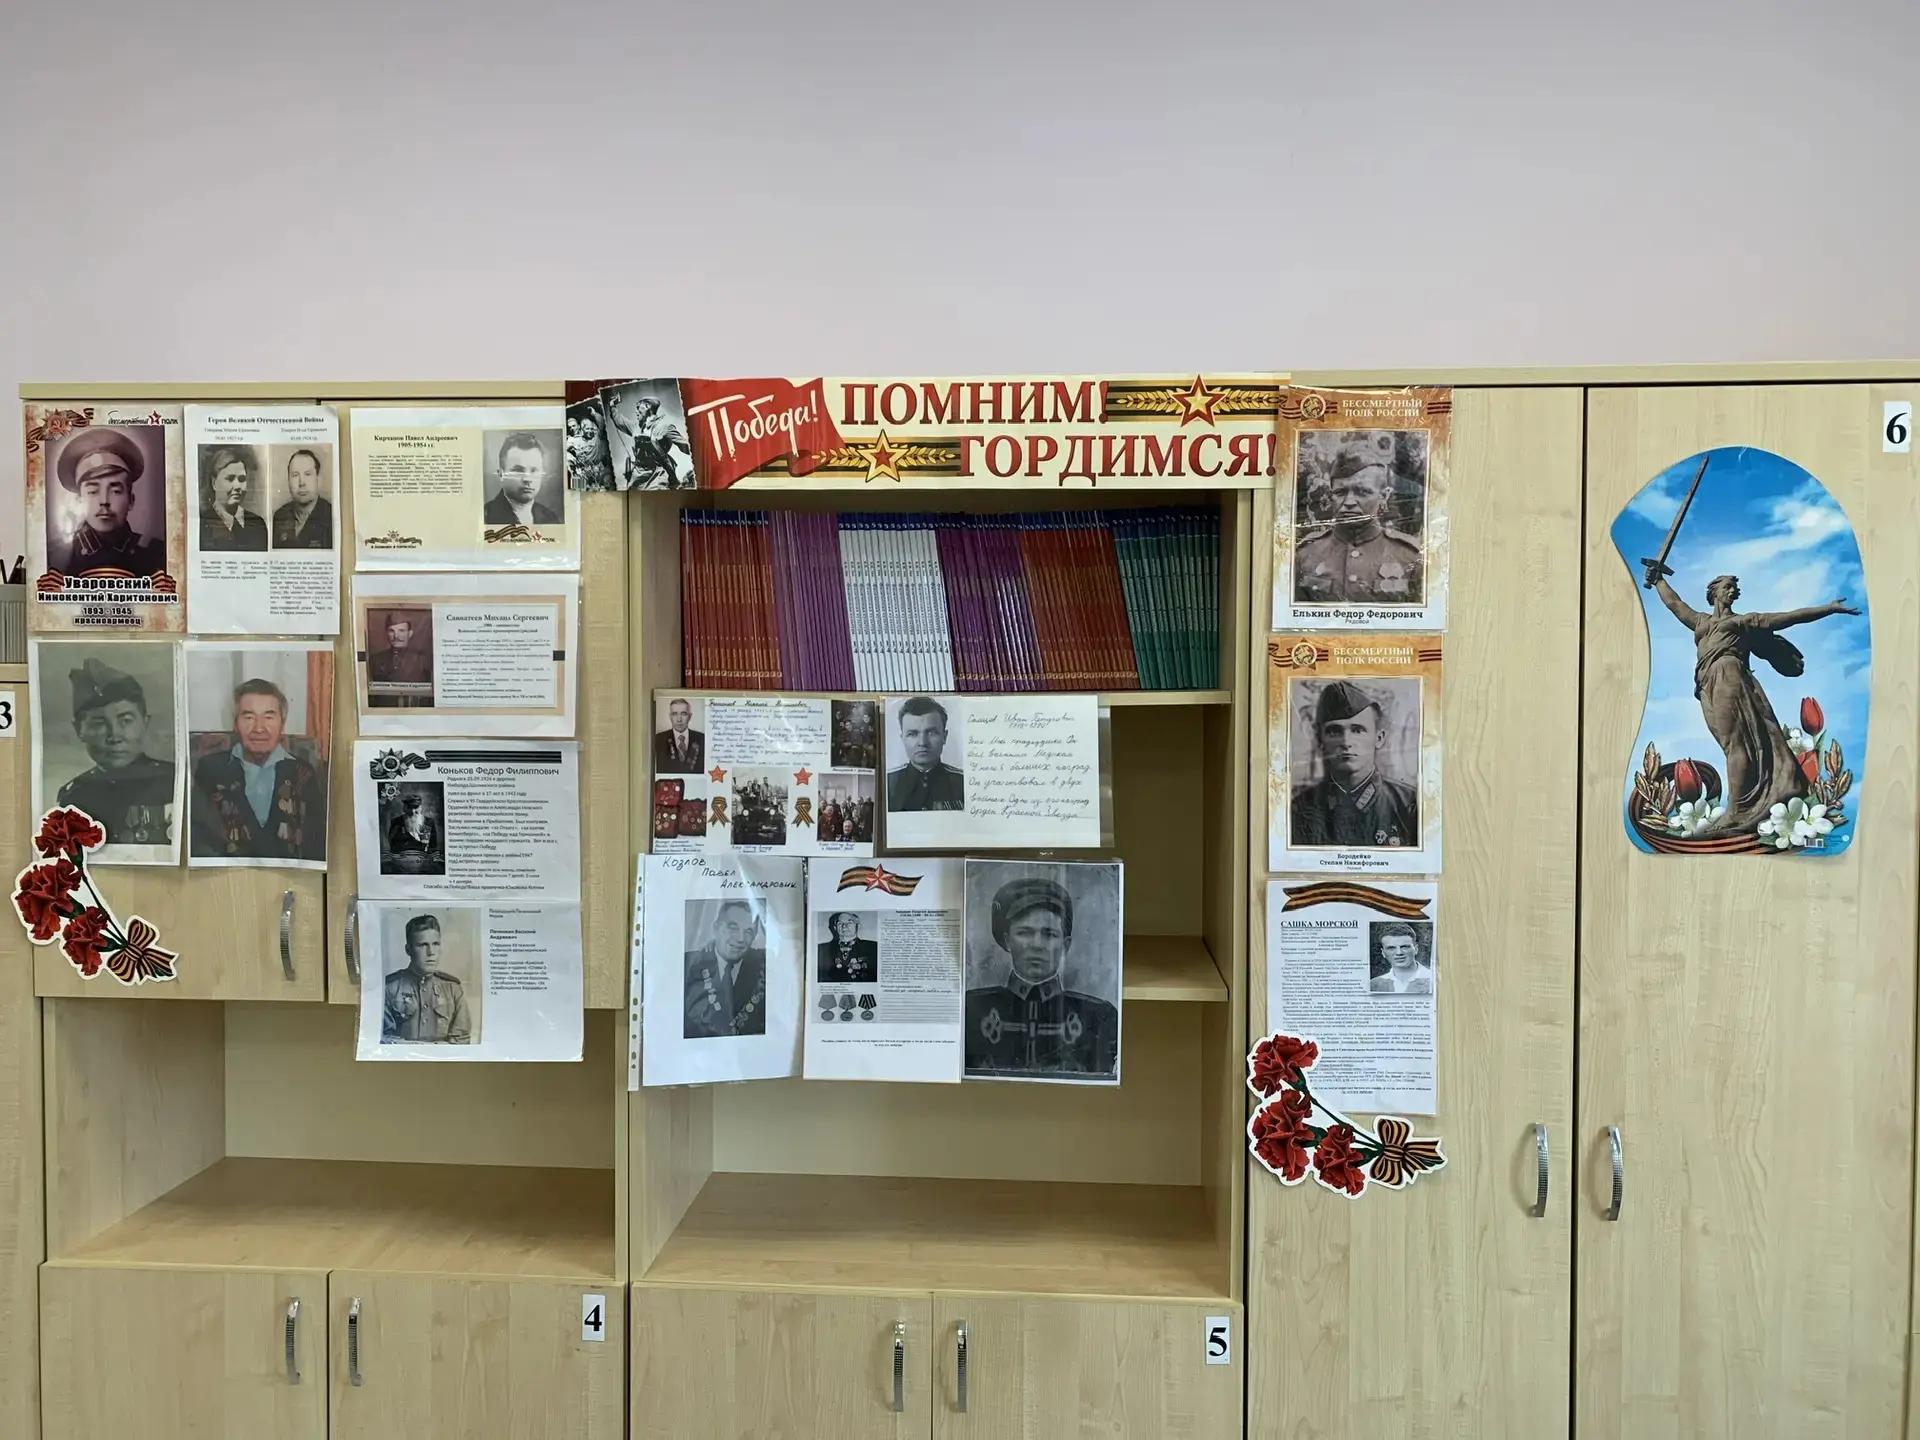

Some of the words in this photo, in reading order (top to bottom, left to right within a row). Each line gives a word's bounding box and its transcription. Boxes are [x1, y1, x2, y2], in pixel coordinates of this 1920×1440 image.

[841, 382, 1108, 425] ПОМНИМ!
[1343, 398, 1422, 407] БЕССМЕРТНЫЙ
[688, 390, 819, 461] Победа!
[1886, 413, 1908, 444] 6
[959, 434, 1277, 487] ГОРДИМСЯ!
[65, 578, 150, 590] Уваровский
[38, 592, 104, 601] Иннокентий
[107, 594, 177, 602] Харитонович
[1293, 610, 1331, 618] Елькин
[1333, 610, 1364, 620] Федор
[1366, 610, 1423, 620] Федорович
[1333, 647, 1413, 656] БЕССМЕРТНЫЙ
[476, 767, 504, 775] Федор
[506, 767, 559, 775] Филиппович
[1315, 919, 1358, 928] МОРСКОЙ
[584, 1305, 602, 1331] 4
[1209, 1327, 1227, 1356] 5
